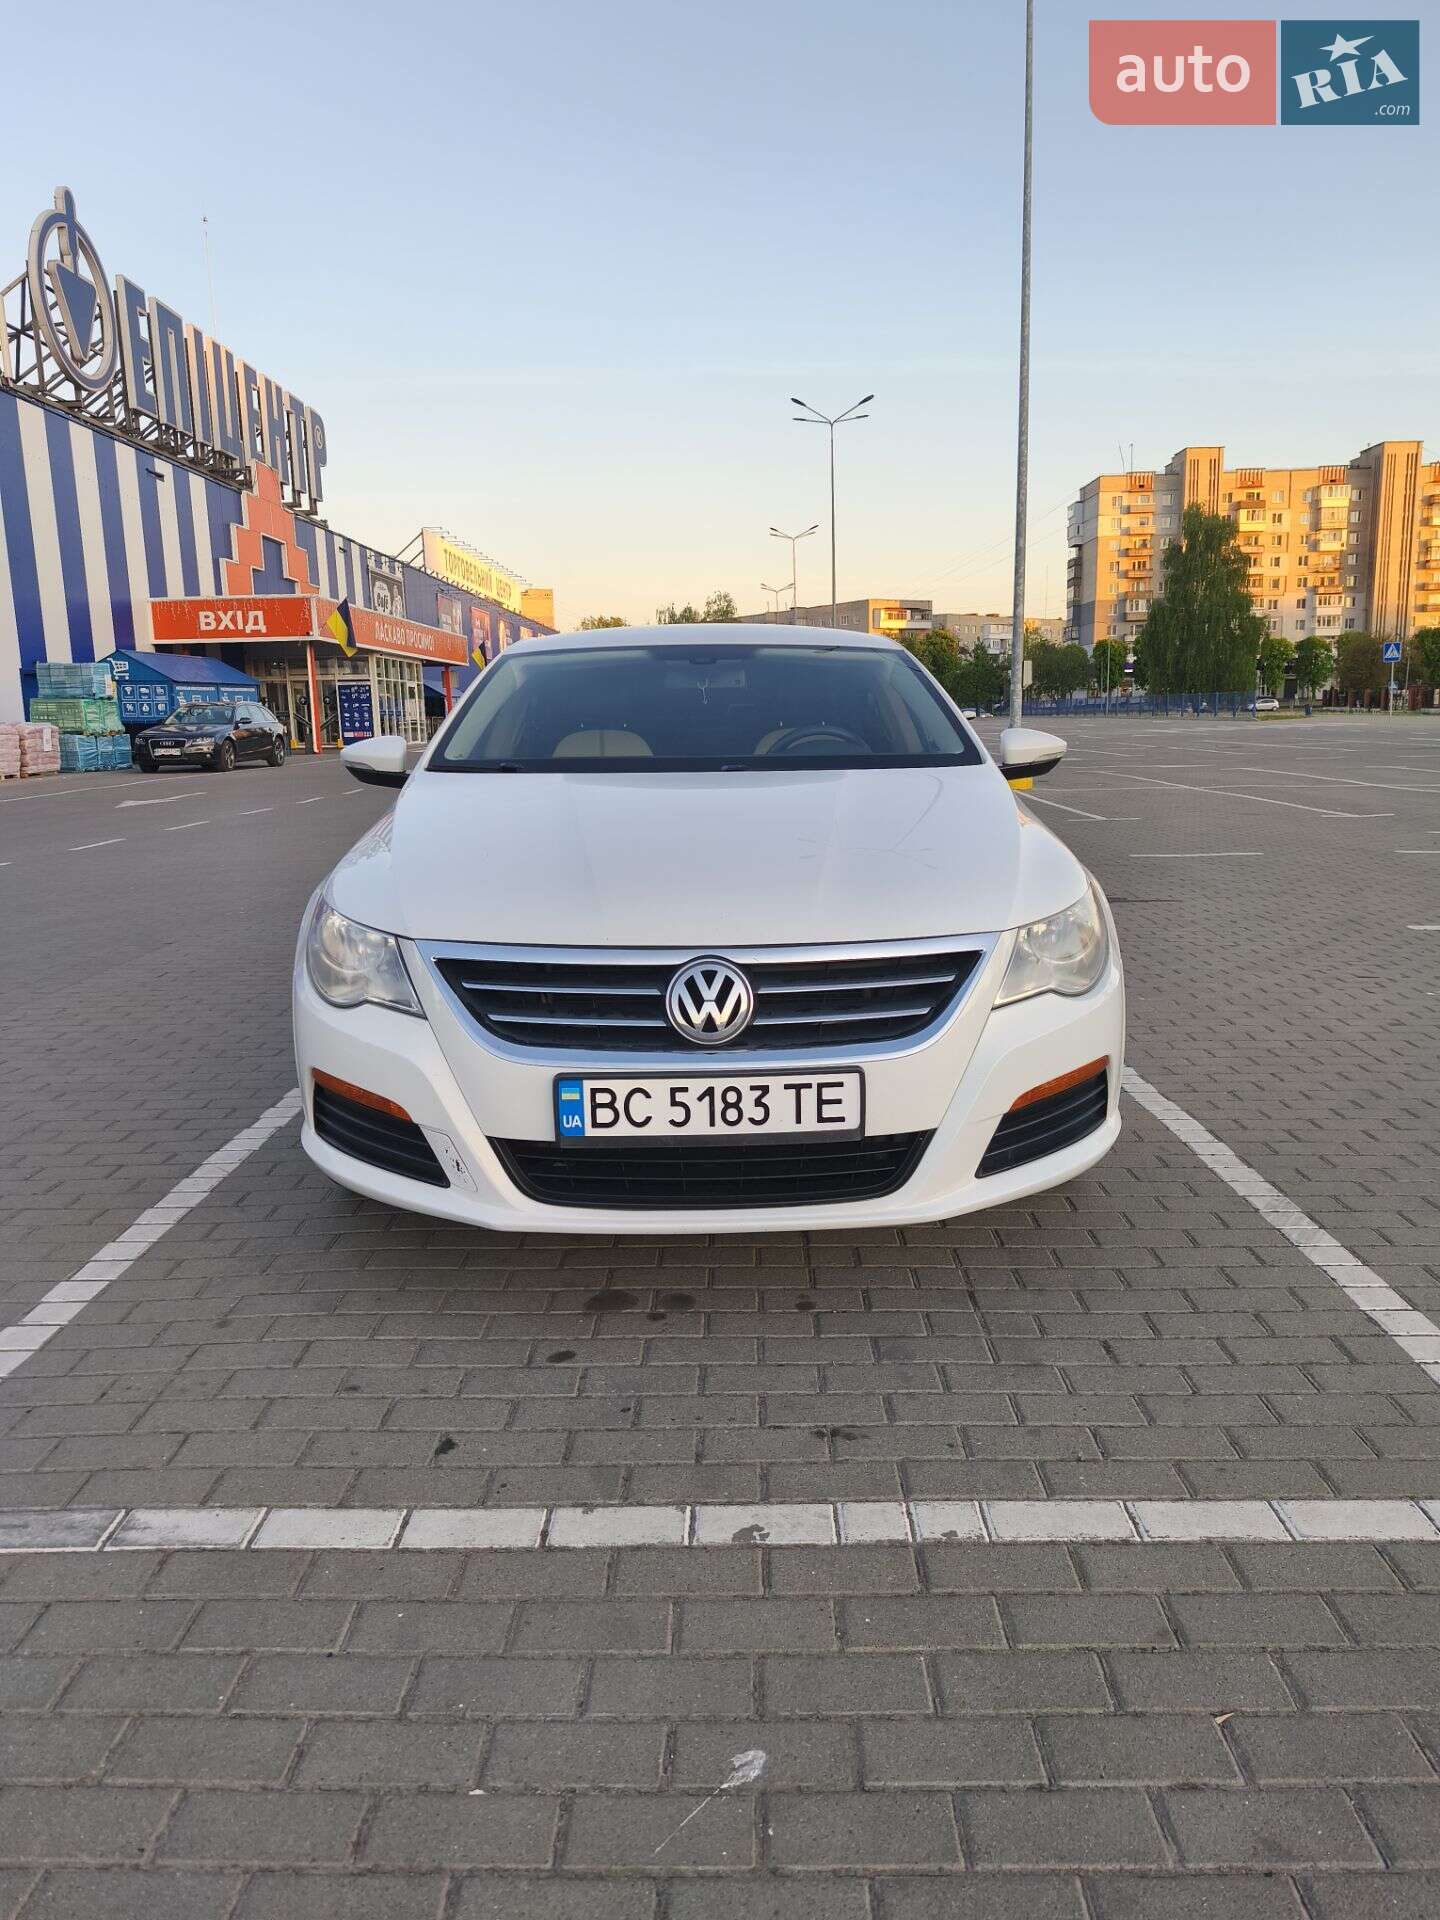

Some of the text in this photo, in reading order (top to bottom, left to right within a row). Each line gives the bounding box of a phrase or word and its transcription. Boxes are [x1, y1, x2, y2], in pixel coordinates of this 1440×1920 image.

[198, 609, 268, 633] ВХІД
[375, 621, 406, 646] ЛАСКАВО
[590, 1081, 846, 1129] BC 5183 TE
[563, 1116, 582, 1128] UA
